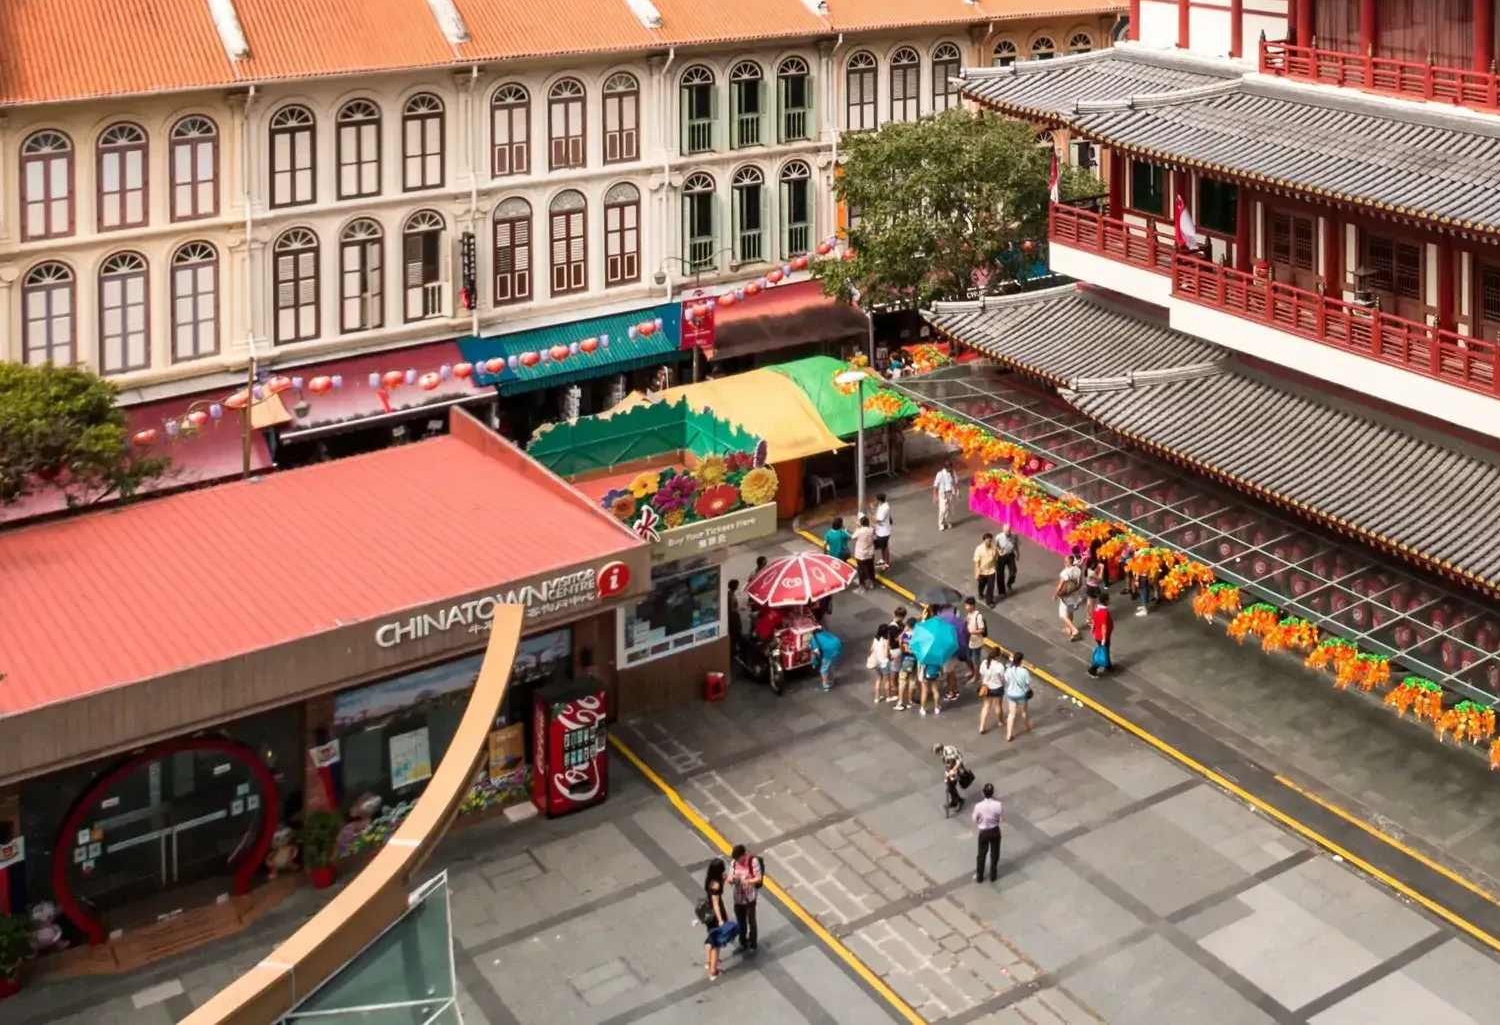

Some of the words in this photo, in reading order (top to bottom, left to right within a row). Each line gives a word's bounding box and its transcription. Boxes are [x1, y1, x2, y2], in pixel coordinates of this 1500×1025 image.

[667, 536, 684, 547] Buy
[686, 530, 704, 542] Your
[705, 523, 735, 537] Tickets
[736, 518, 756, 528] Here
[548, 568, 595, 590] VISITOR
[548, 580, 595, 600] CENTRE
[375, 581, 549, 647] CHINATOWN
